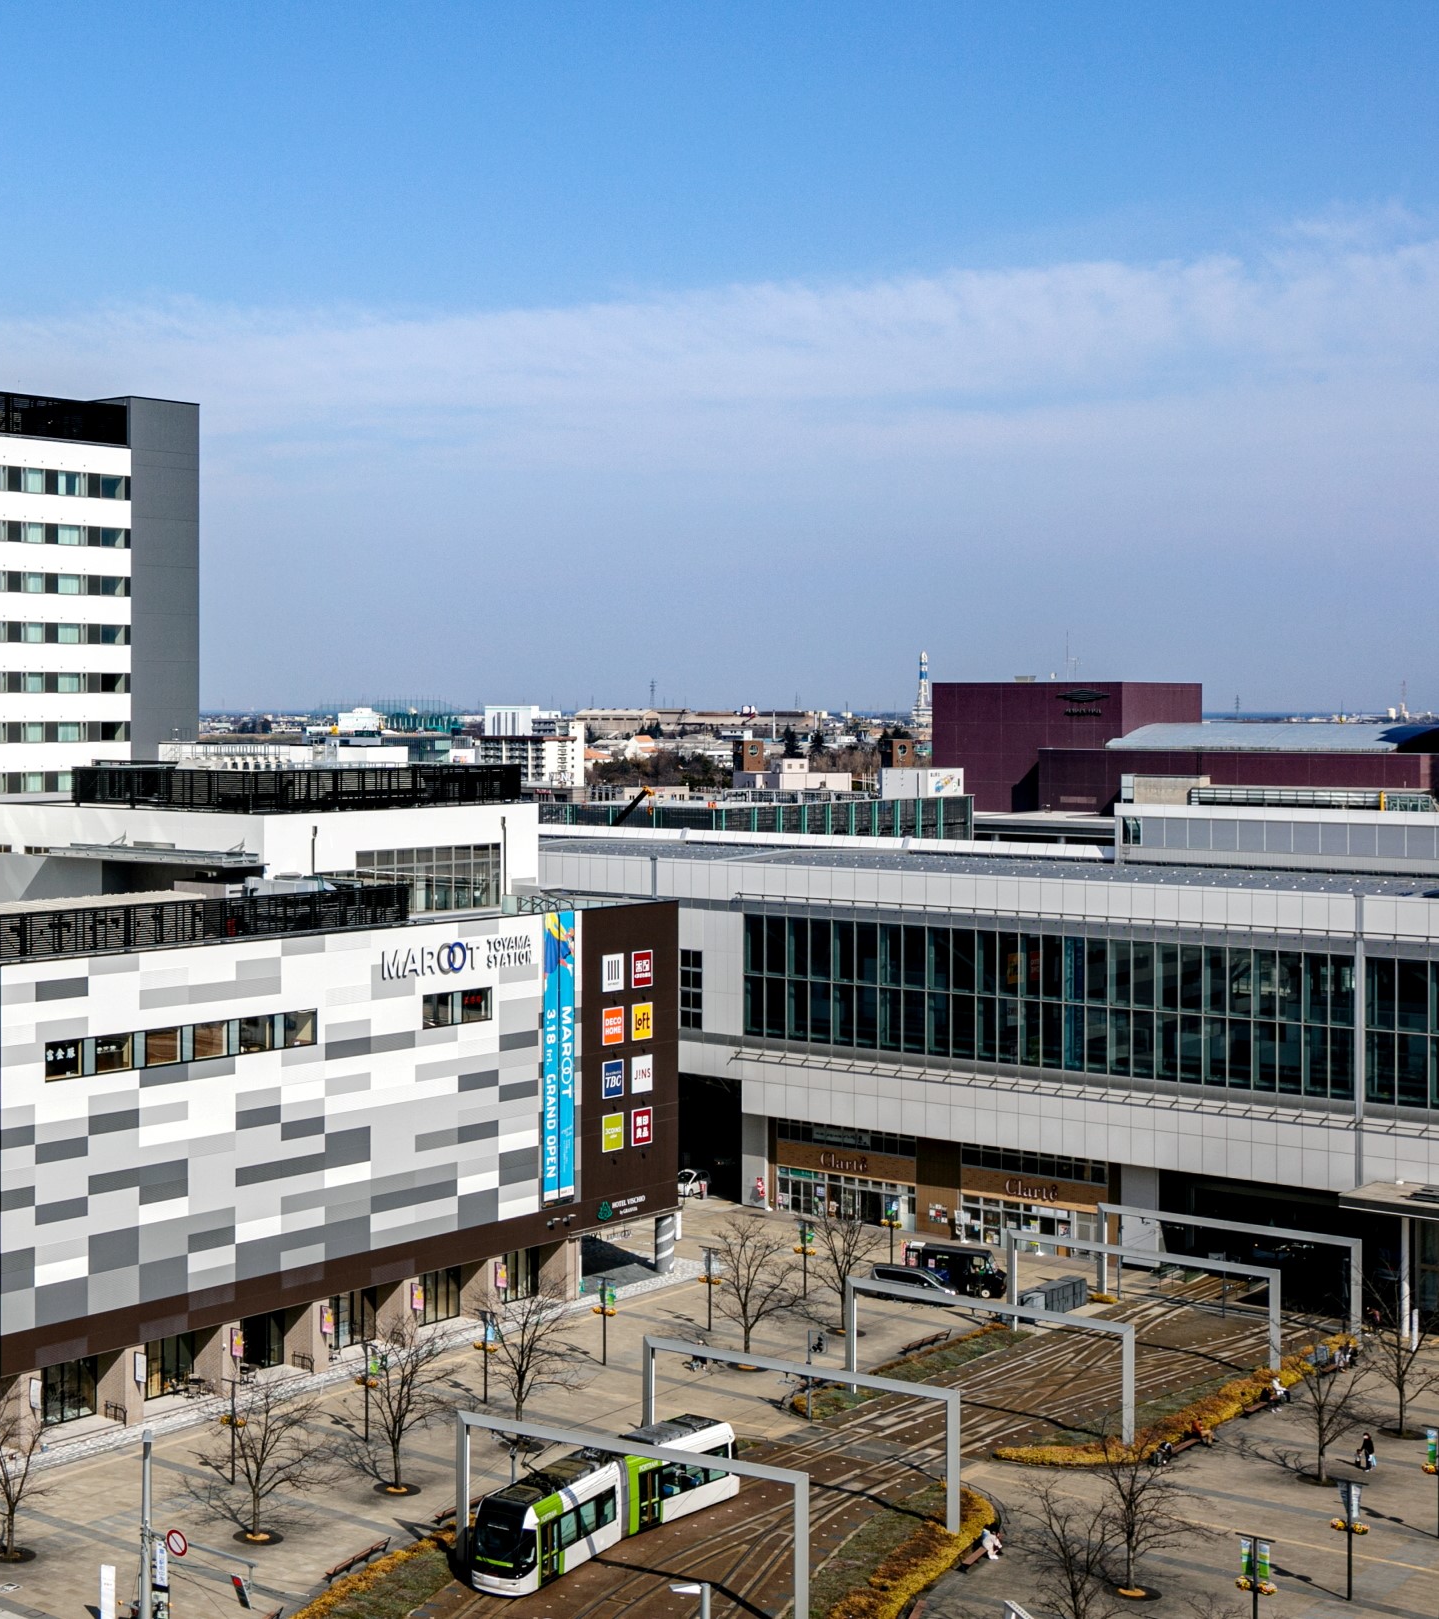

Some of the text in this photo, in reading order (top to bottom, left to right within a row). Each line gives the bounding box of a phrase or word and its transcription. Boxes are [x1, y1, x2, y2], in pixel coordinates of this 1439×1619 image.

[486, 935, 531, 953] TOYAMA
[381, 941, 479, 981] MAROOT
[486, 950, 532, 969] STATION
[546, 1009, 556, 1045] 3.18
[605, 1017, 622, 1027] DECO
[605, 1026, 622, 1035] HOME
[562, 1006, 573, 1098] MAROOT
[605, 1075, 622, 1089] TBC
[546, 1073, 556, 1130] GRAND
[546, 1135, 556, 1178] OPEN
